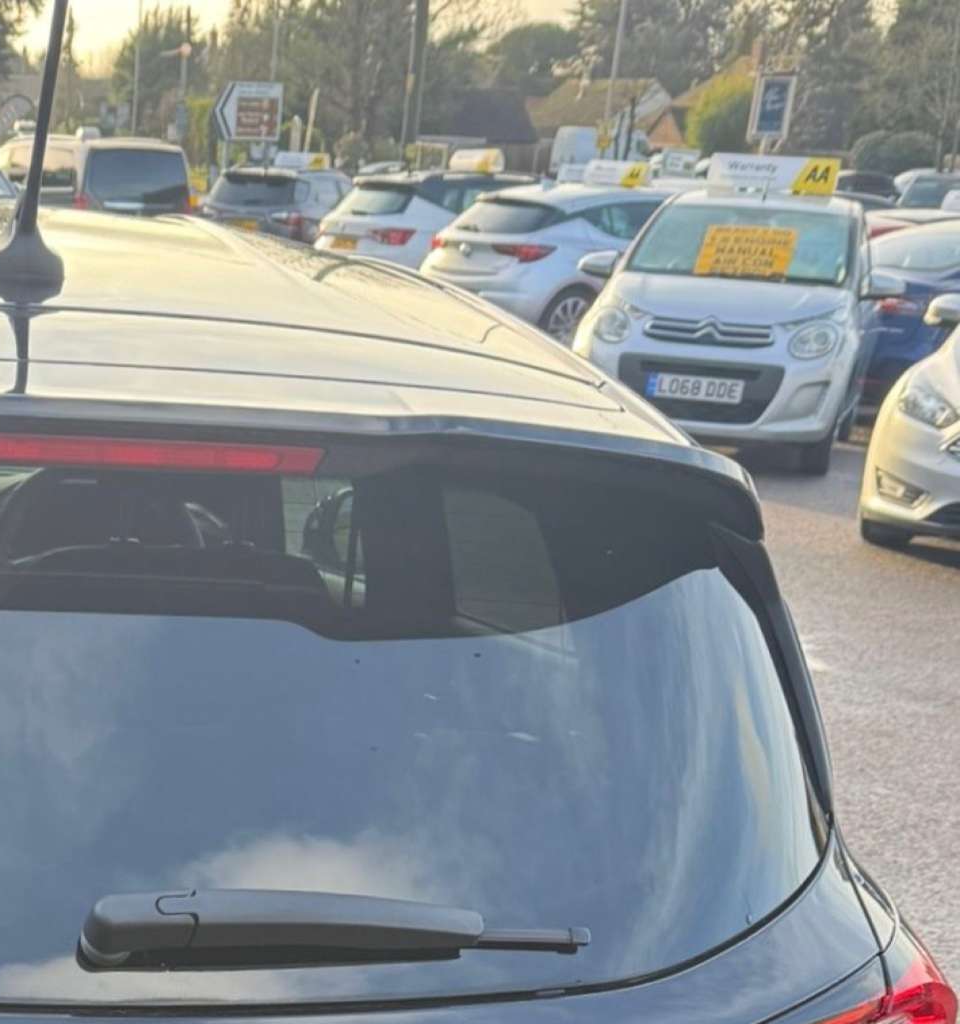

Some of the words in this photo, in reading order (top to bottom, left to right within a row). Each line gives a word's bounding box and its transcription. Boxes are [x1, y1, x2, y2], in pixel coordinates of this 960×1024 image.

[728, 160, 779, 174] Warranty
[805, 164, 832, 183] AA
[715, 245, 777, 257] MANUAL
